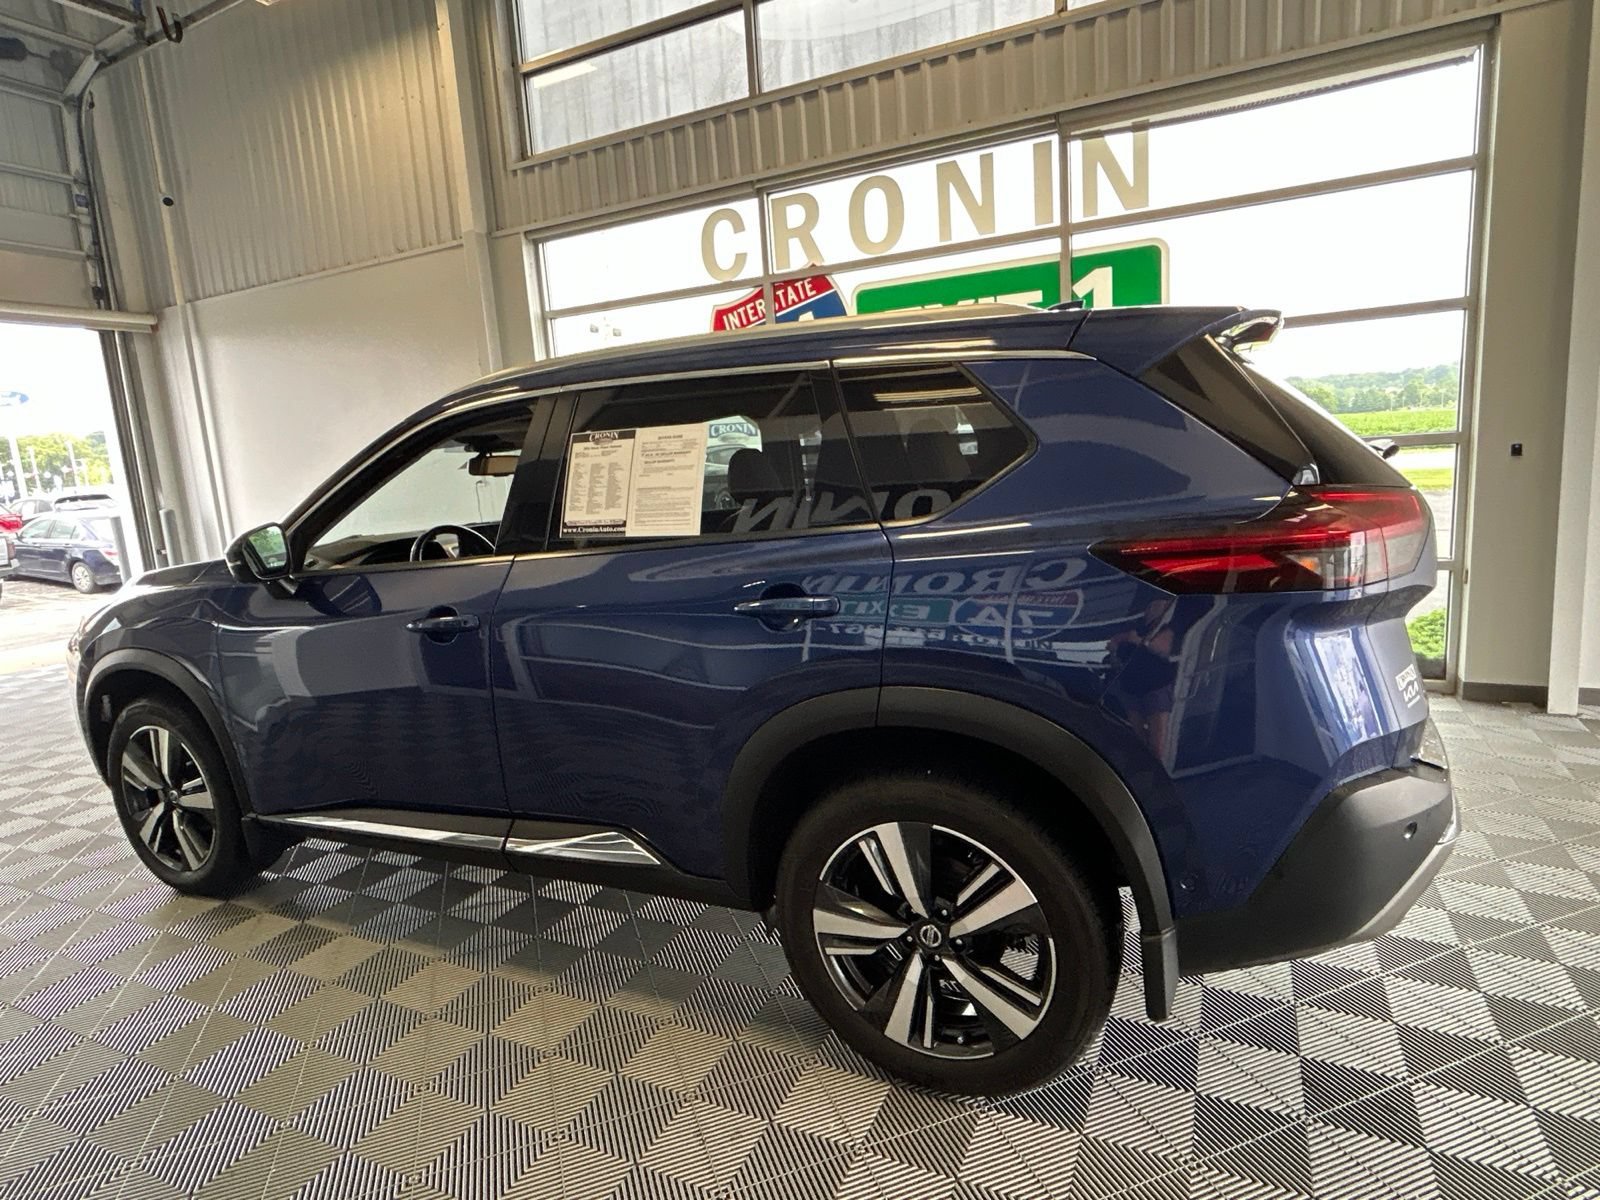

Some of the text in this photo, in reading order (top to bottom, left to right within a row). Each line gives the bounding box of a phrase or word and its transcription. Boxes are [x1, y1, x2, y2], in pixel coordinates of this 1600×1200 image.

[701, 119, 1150, 282] CRONIN
[722, 278, 817, 331] INTERTATE
[710, 423, 757, 437] CRONIN
